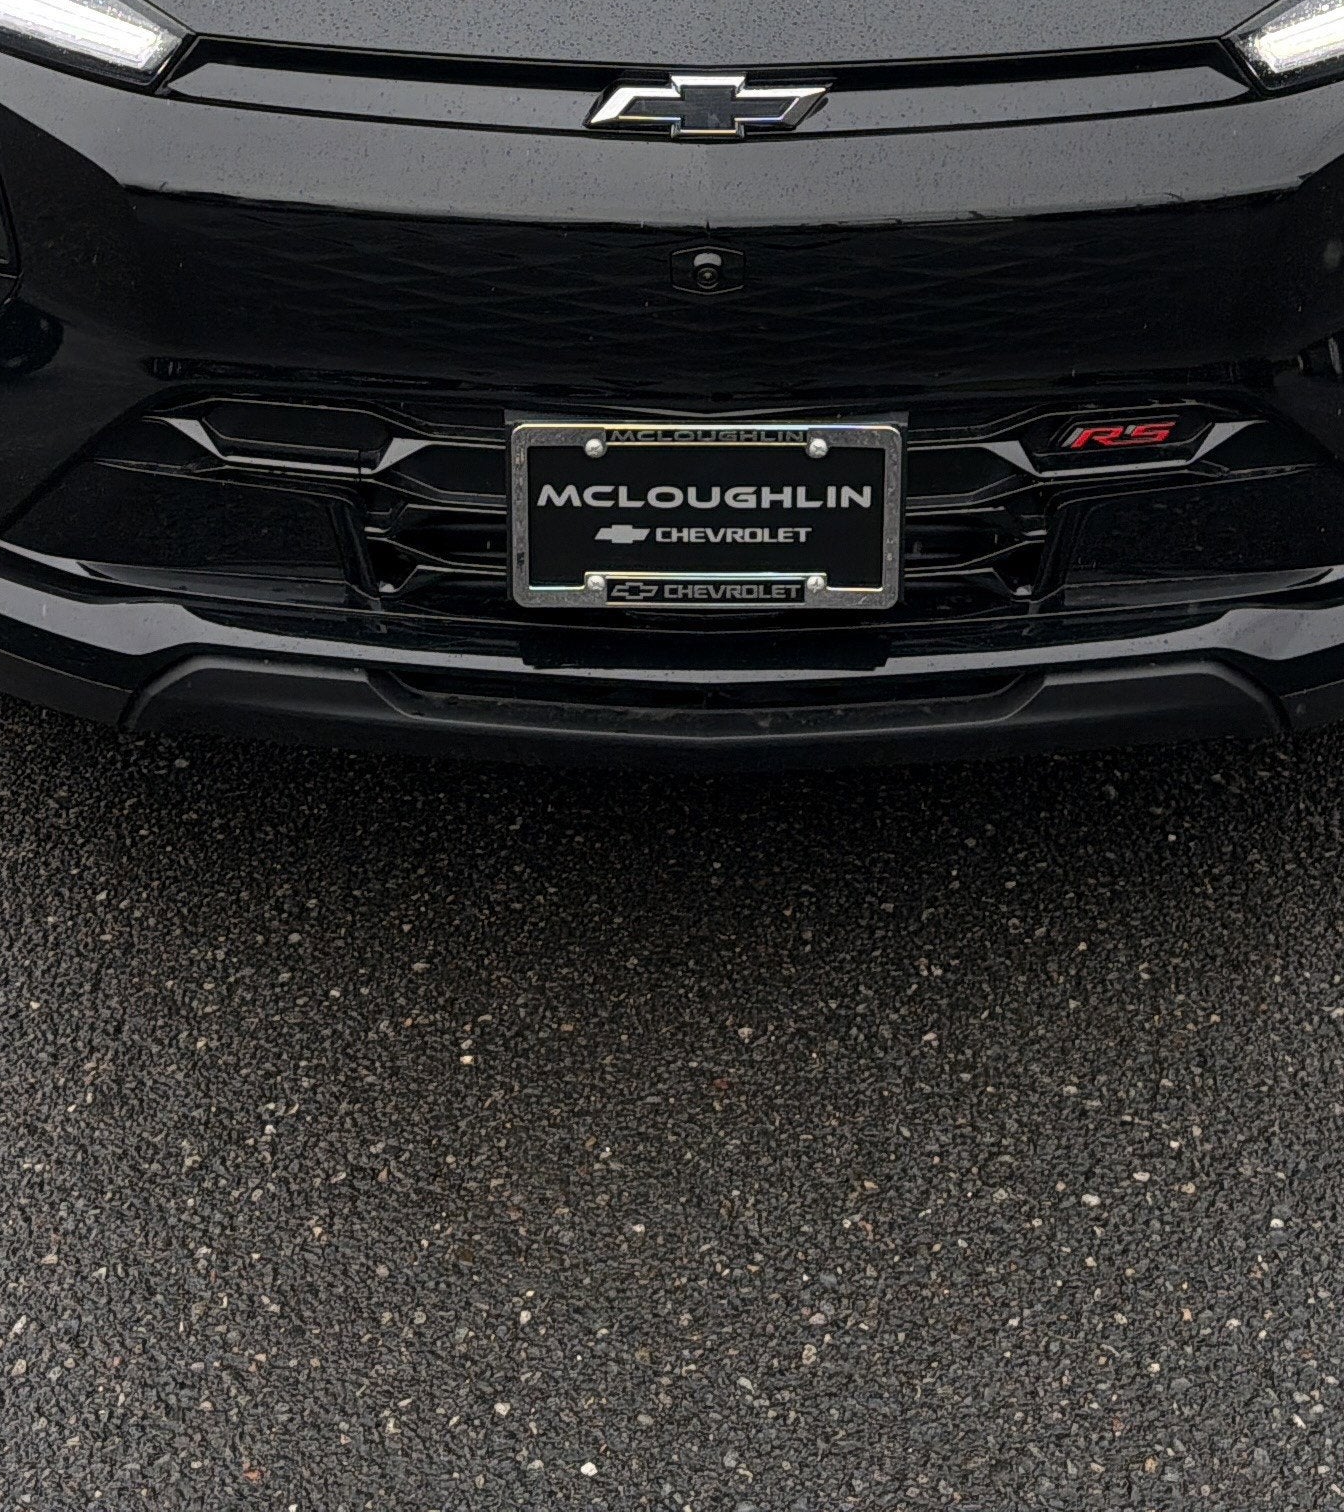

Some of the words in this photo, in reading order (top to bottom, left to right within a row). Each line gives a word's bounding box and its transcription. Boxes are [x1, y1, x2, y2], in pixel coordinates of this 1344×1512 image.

[608, 429, 806, 443] MCLOUGHLIN
[1061, 421, 1176, 449] RS
[537, 484, 872, 509] MCLOUGHLIN
[655, 527, 812, 544] CHEVROLET
[663, 584, 803, 600] CHEVROLET
